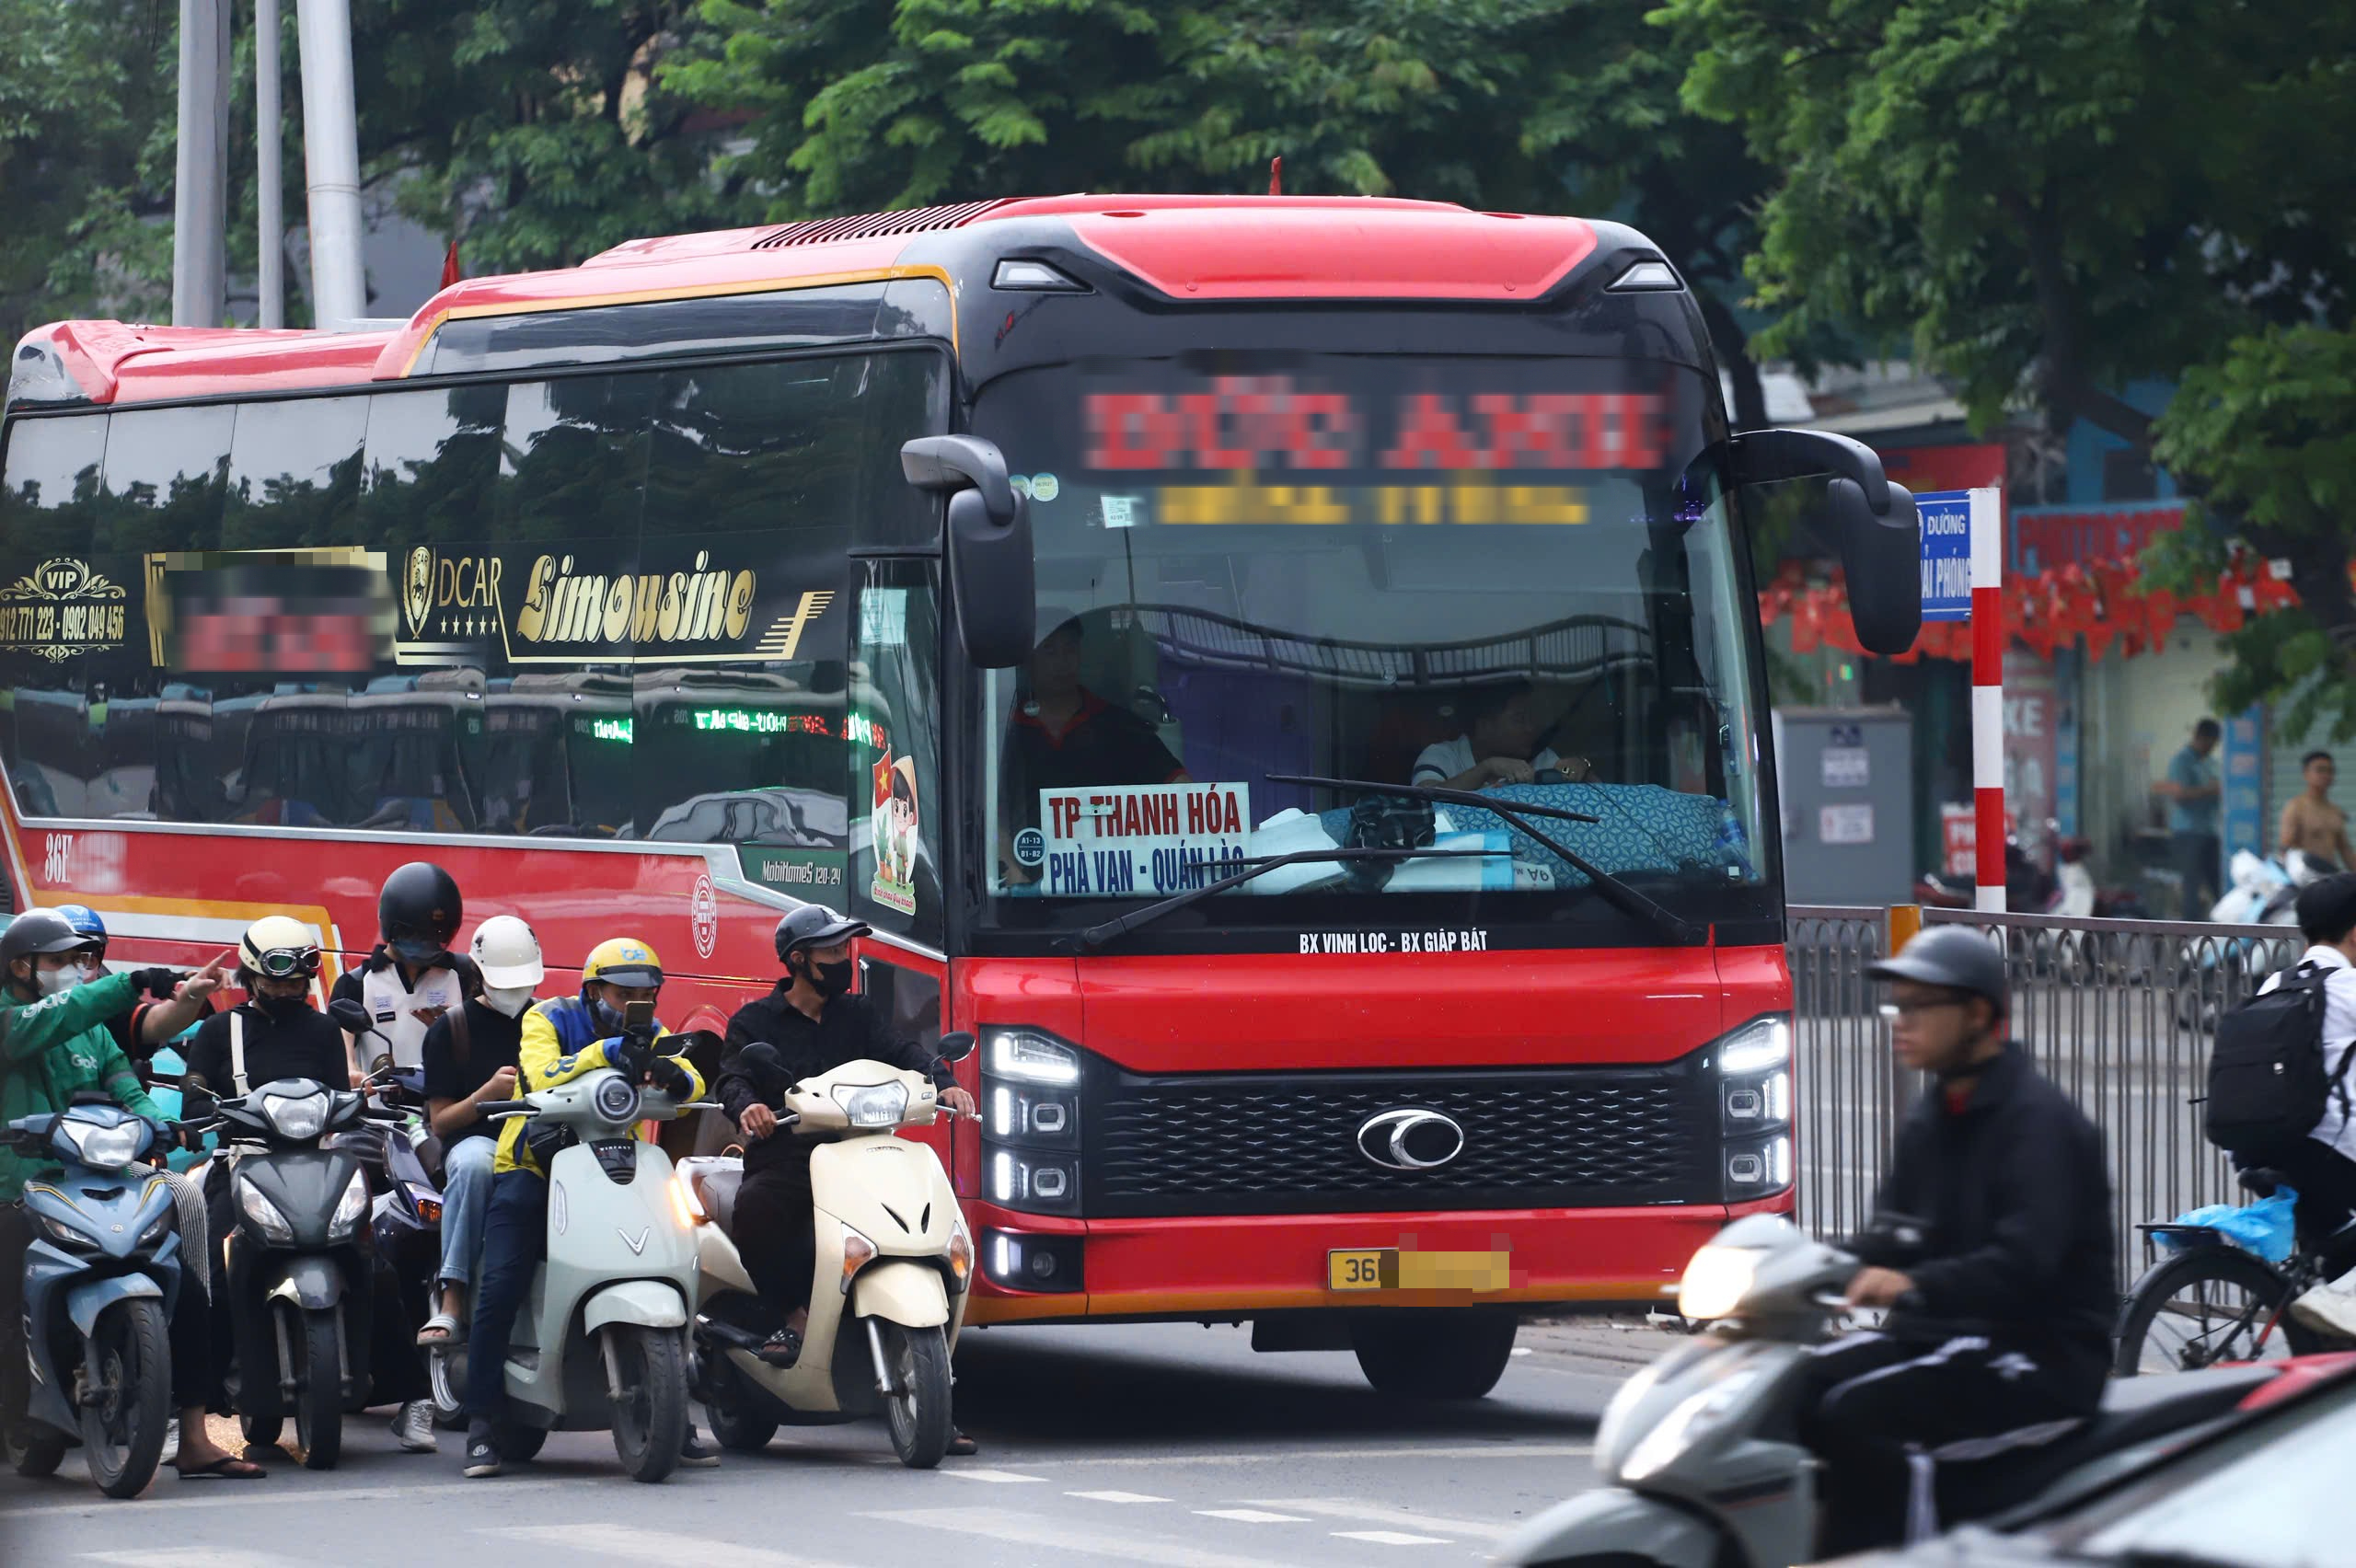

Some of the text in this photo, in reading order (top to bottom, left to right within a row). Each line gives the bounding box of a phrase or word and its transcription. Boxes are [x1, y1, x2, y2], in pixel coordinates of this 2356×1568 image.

[1927, 508, 1966, 535] ĐƯỜNG
[47, 571, 77, 589] VIP
[438, 557, 502, 607] DCAR
[516, 550, 756, 642] Limousine
[18, 607, 34, 640] 771
[36, 606, 54, 640] 223
[62, 605, 87, 640] 0902
[87, 605, 106, 640] 049
[107, 605, 124, 640] 456
[1049, 784, 1242, 839] TP THANH HÓA
[1050, 844, 1091, 894] PHÀ
[1093, 849, 1134, 897] VẠN
[1152, 839, 1204, 895] QUÁN
[620, 945, 648, 962] be
[1299, 933, 1319, 954] BX
[1322, 932, 1357, 954] VINH
[1360, 932, 1387, 953] LOC
[1401, 932, 1420, 953] BX
[1424, 928, 1458, 953] GIÁP
[1461, 927, 1487, 951] BÁT
[22, 989, 72, 1019] Grab
[1345, 1258, 1380, 1283] 36
